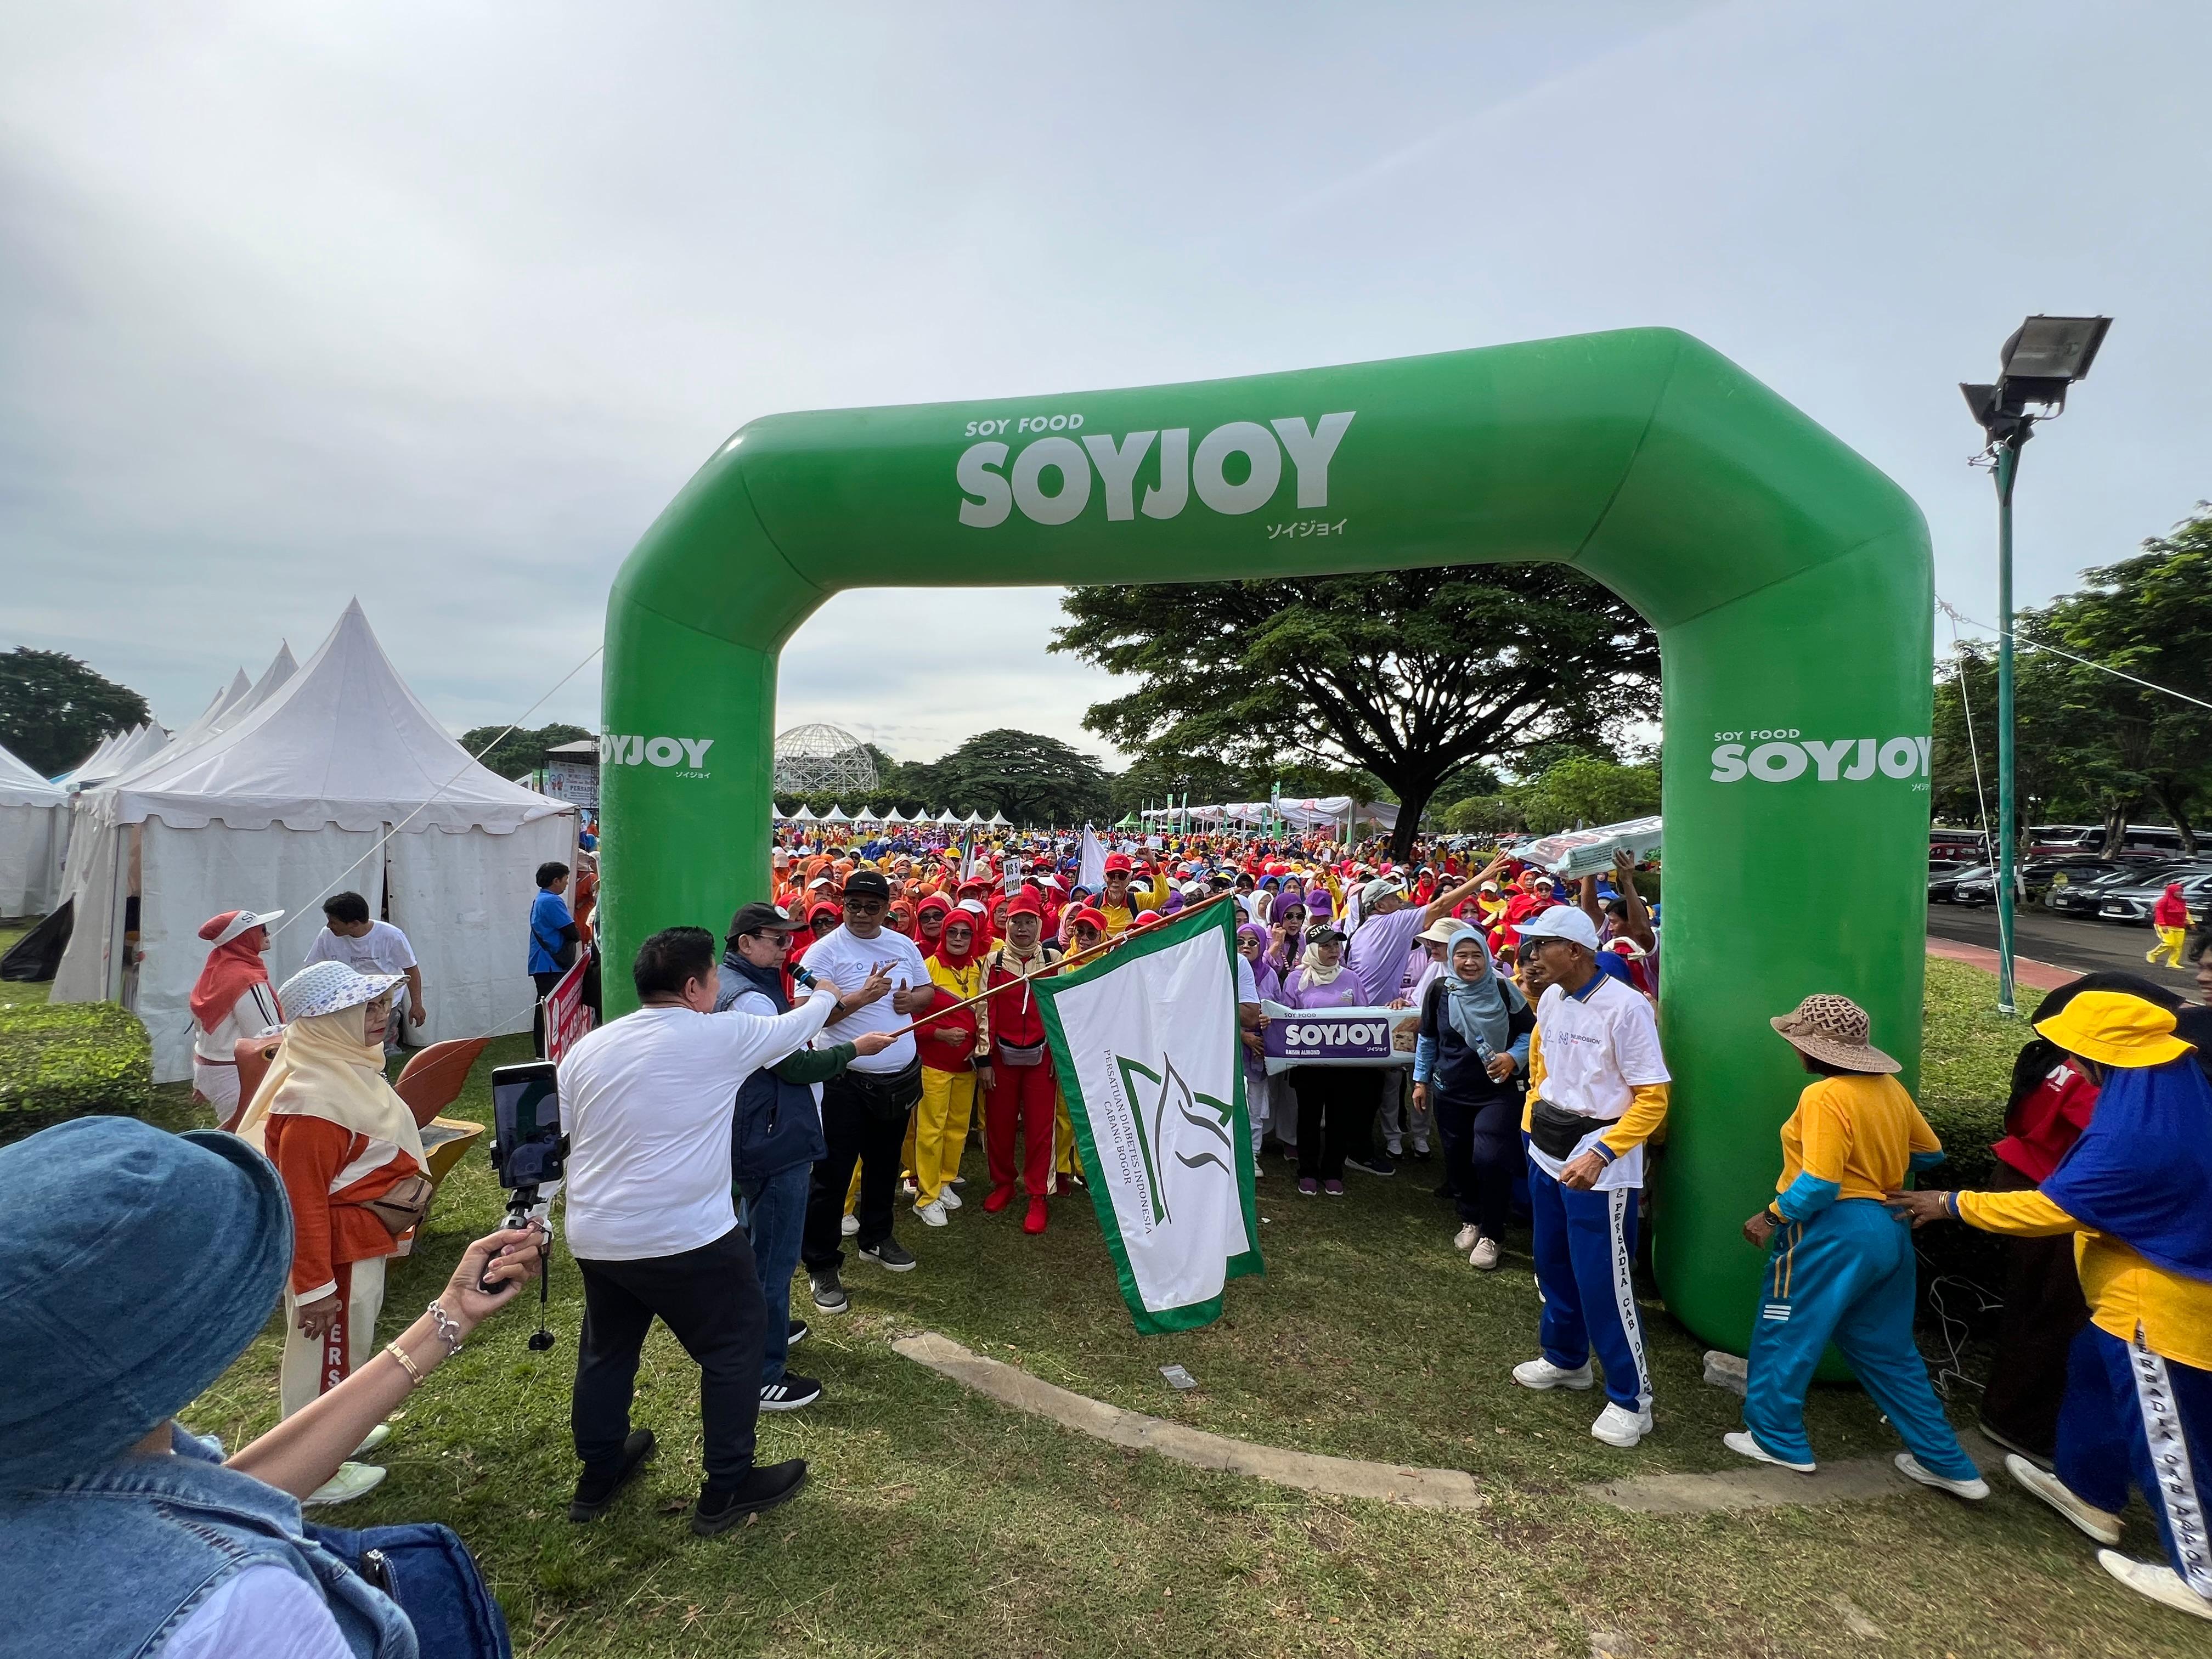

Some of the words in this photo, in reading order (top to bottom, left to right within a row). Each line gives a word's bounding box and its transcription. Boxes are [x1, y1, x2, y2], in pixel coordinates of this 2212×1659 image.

[964, 419, 1011, 437] SOY
[1018, 414, 1085, 433] FOOD
[956, 411, 1357, 528] SOYJOY
[1267, 518, 1348, 540] ソイジョイ
[1714, 731, 1743, 742] SOY
[1750, 729, 1801, 740] FOOD
[1709, 736, 1932, 783] SOYJOY
[1006, 863, 1014, 876] BIS
[1014, 862, 1018, 874] 5
[1310, 924, 1333, 938] SPO
[1285, 1023, 1387, 1046] SOYJOY
[1104, 1049, 1125, 1111] PERSATUAN
[1119, 1114, 1140, 1167] DIABETES
[1133, 1170, 1152, 1235] INDONESIA
[1104, 1101, 1122, 1144] CABANG
[1116, 1147, 1132, 1185] BOGOR
[1614, 1203, 1628, 1288] PERSADIA
[1623, 1297, 1635, 1330] CAB
